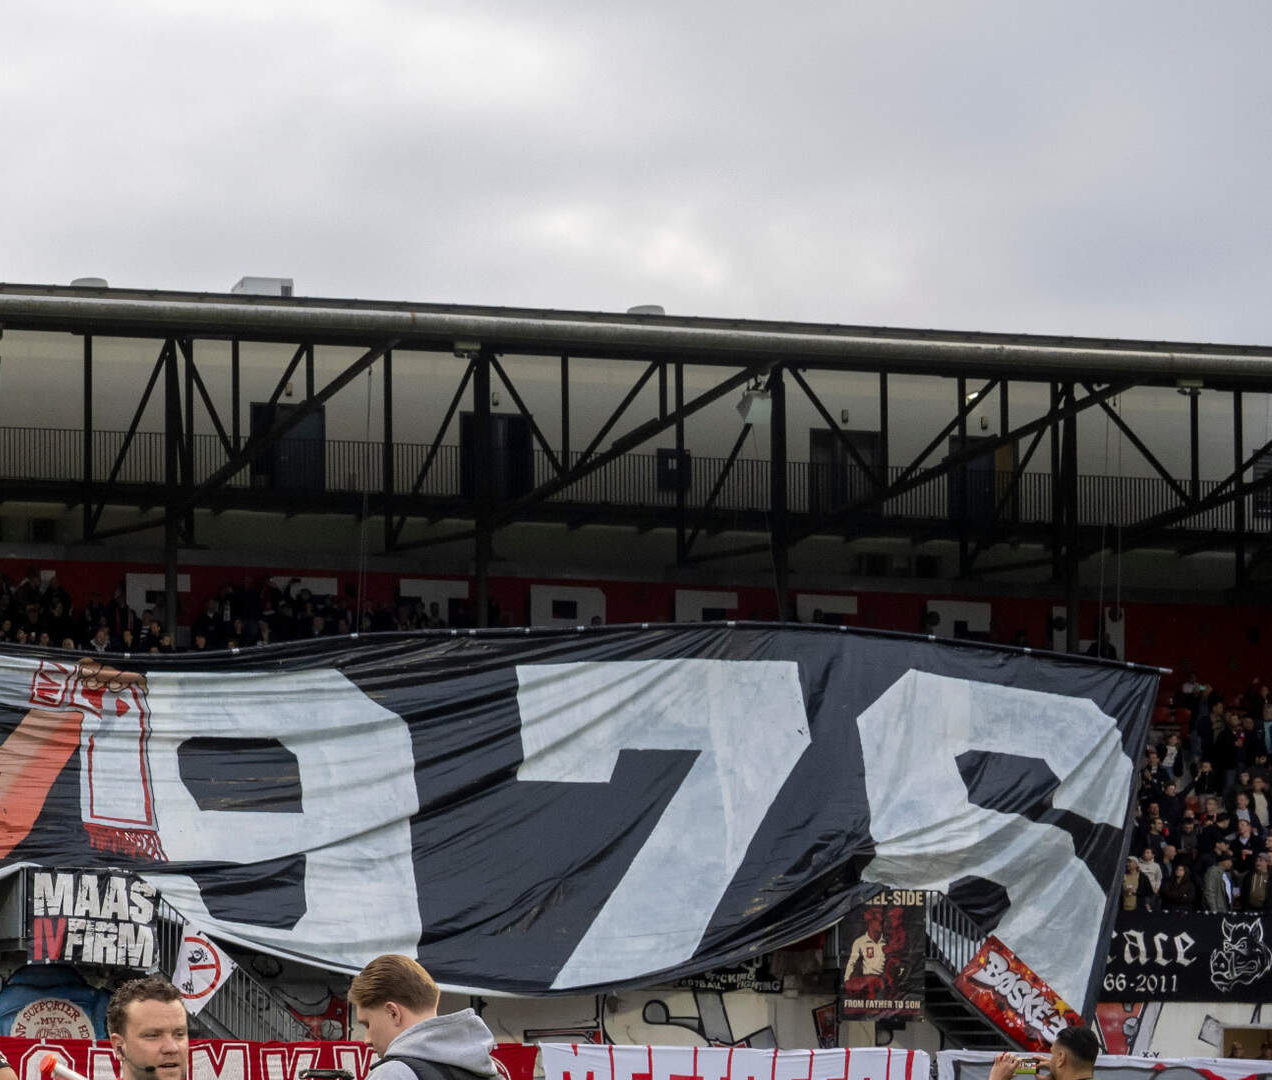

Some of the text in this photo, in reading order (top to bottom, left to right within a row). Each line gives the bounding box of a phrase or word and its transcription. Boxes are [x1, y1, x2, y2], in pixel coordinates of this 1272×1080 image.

[33, 872, 157, 924] MAAS
[23, 1001, 81, 1023] SUPPORTER
[865, 1000, 892, 1009] FATHER
[894, 1000, 904, 1009] TO
[905, 1000, 921, 1009] SON
